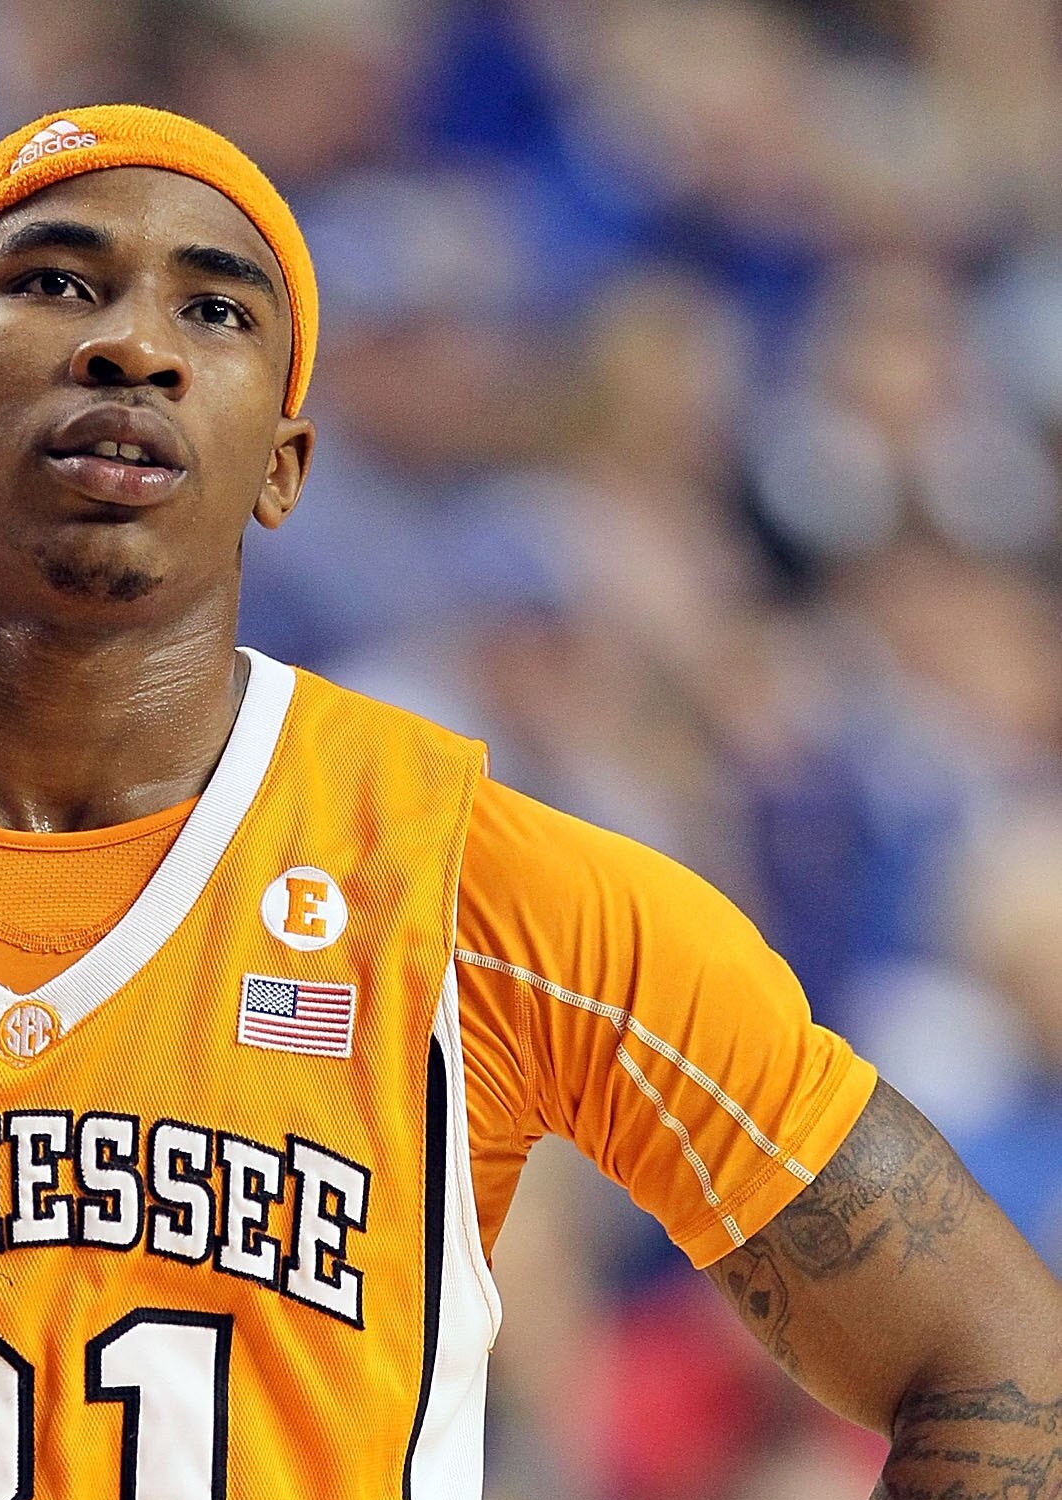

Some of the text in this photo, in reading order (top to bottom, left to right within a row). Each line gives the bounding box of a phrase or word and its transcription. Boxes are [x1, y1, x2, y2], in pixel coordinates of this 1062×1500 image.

[10, 133, 98, 175] adidas
[284, 877, 328, 938] E
[5, 1006, 53, 1057] SEC
